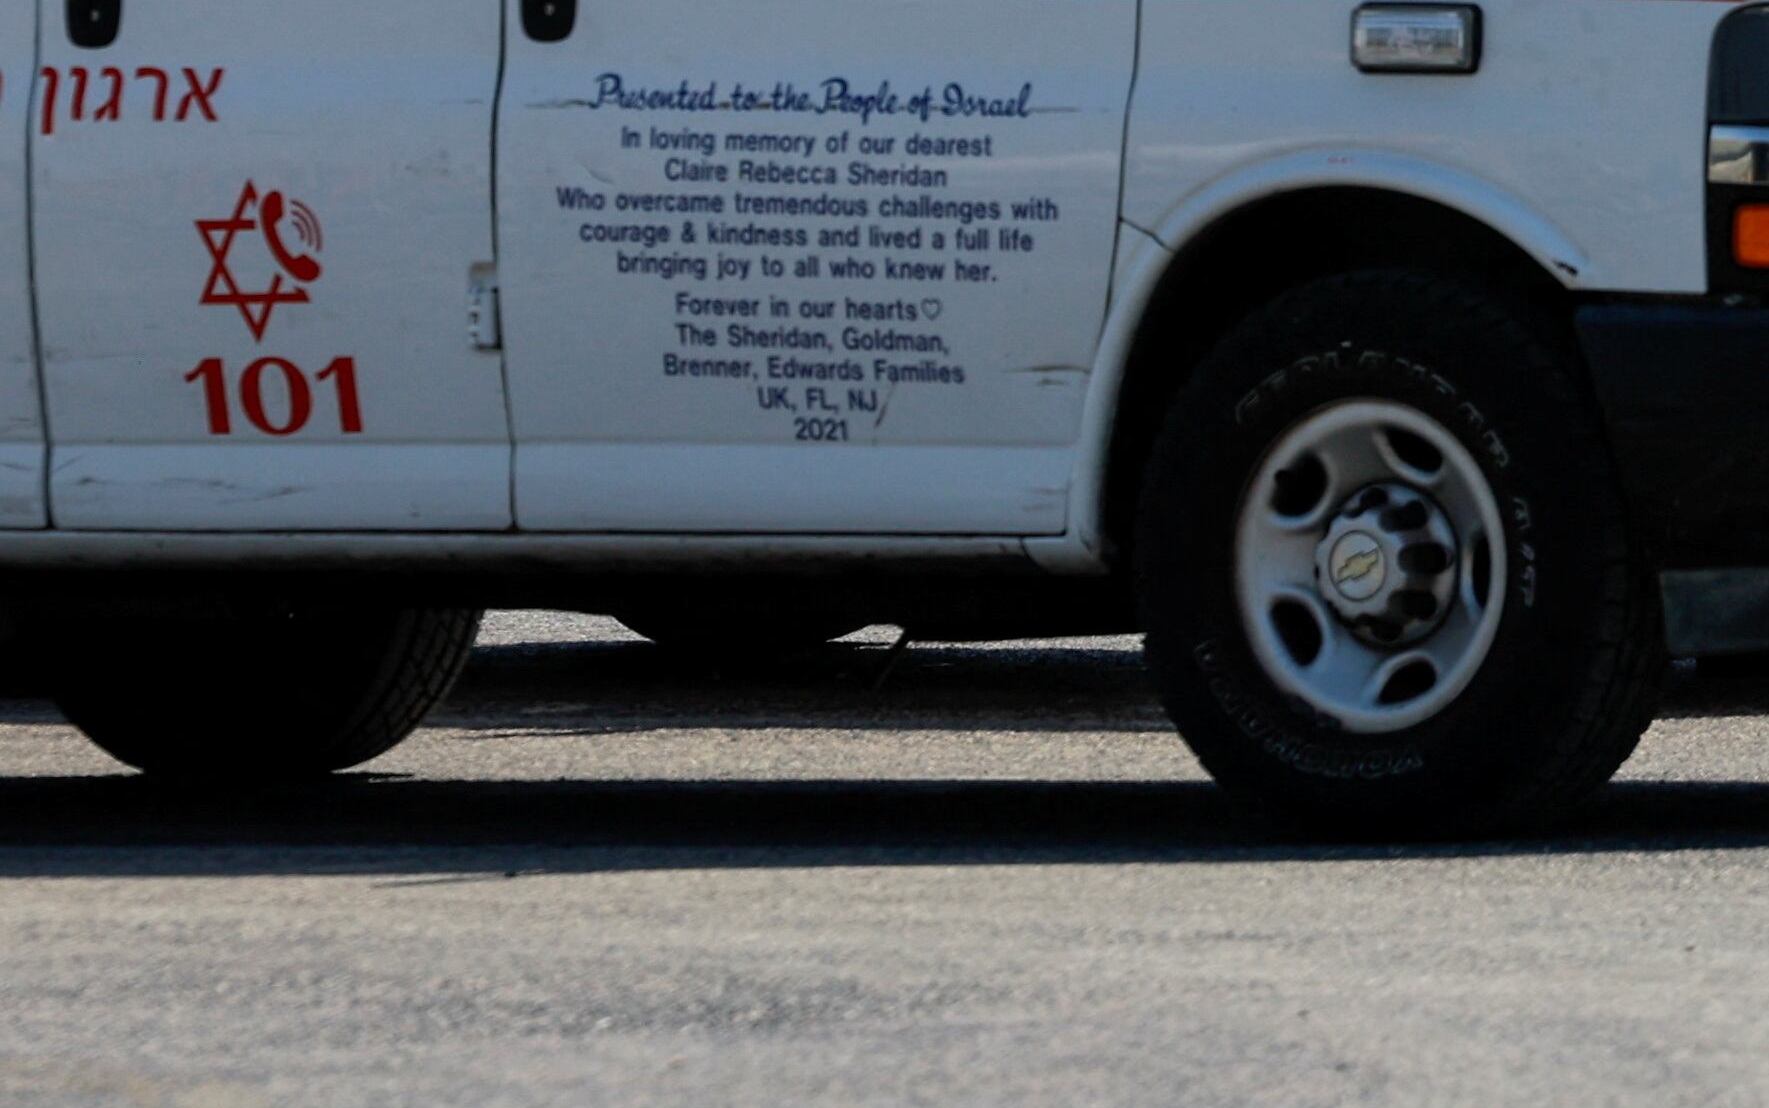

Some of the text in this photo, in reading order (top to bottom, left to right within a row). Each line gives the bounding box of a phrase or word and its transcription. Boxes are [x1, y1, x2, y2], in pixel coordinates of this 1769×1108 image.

[40, 65, 227, 136] ארגון
[588, 72, 1032, 126] Presented to the People of Israel
[621, 125, 992, 158] In loving memory of our dearest
[664, 157, 947, 187] Claire Rebecca Sheridan
[556, 186, 1059, 225] Who overcame tremendous challenges with
[579, 219, 1034, 252] courage & kindness and lived a full life
[616, 250, 997, 283] bringing joy to all who knew her.
[675, 292, 918, 321] Forever in our hearts
[674, 322, 951, 355] The Sheridan, Goldman,
[663, 352, 965, 385] Brenner, Edwards Families
[184, 355, 364, 436] 101
[757, 386, 879, 413] UK, FL, NJ
[794, 416, 849, 442] 2021
